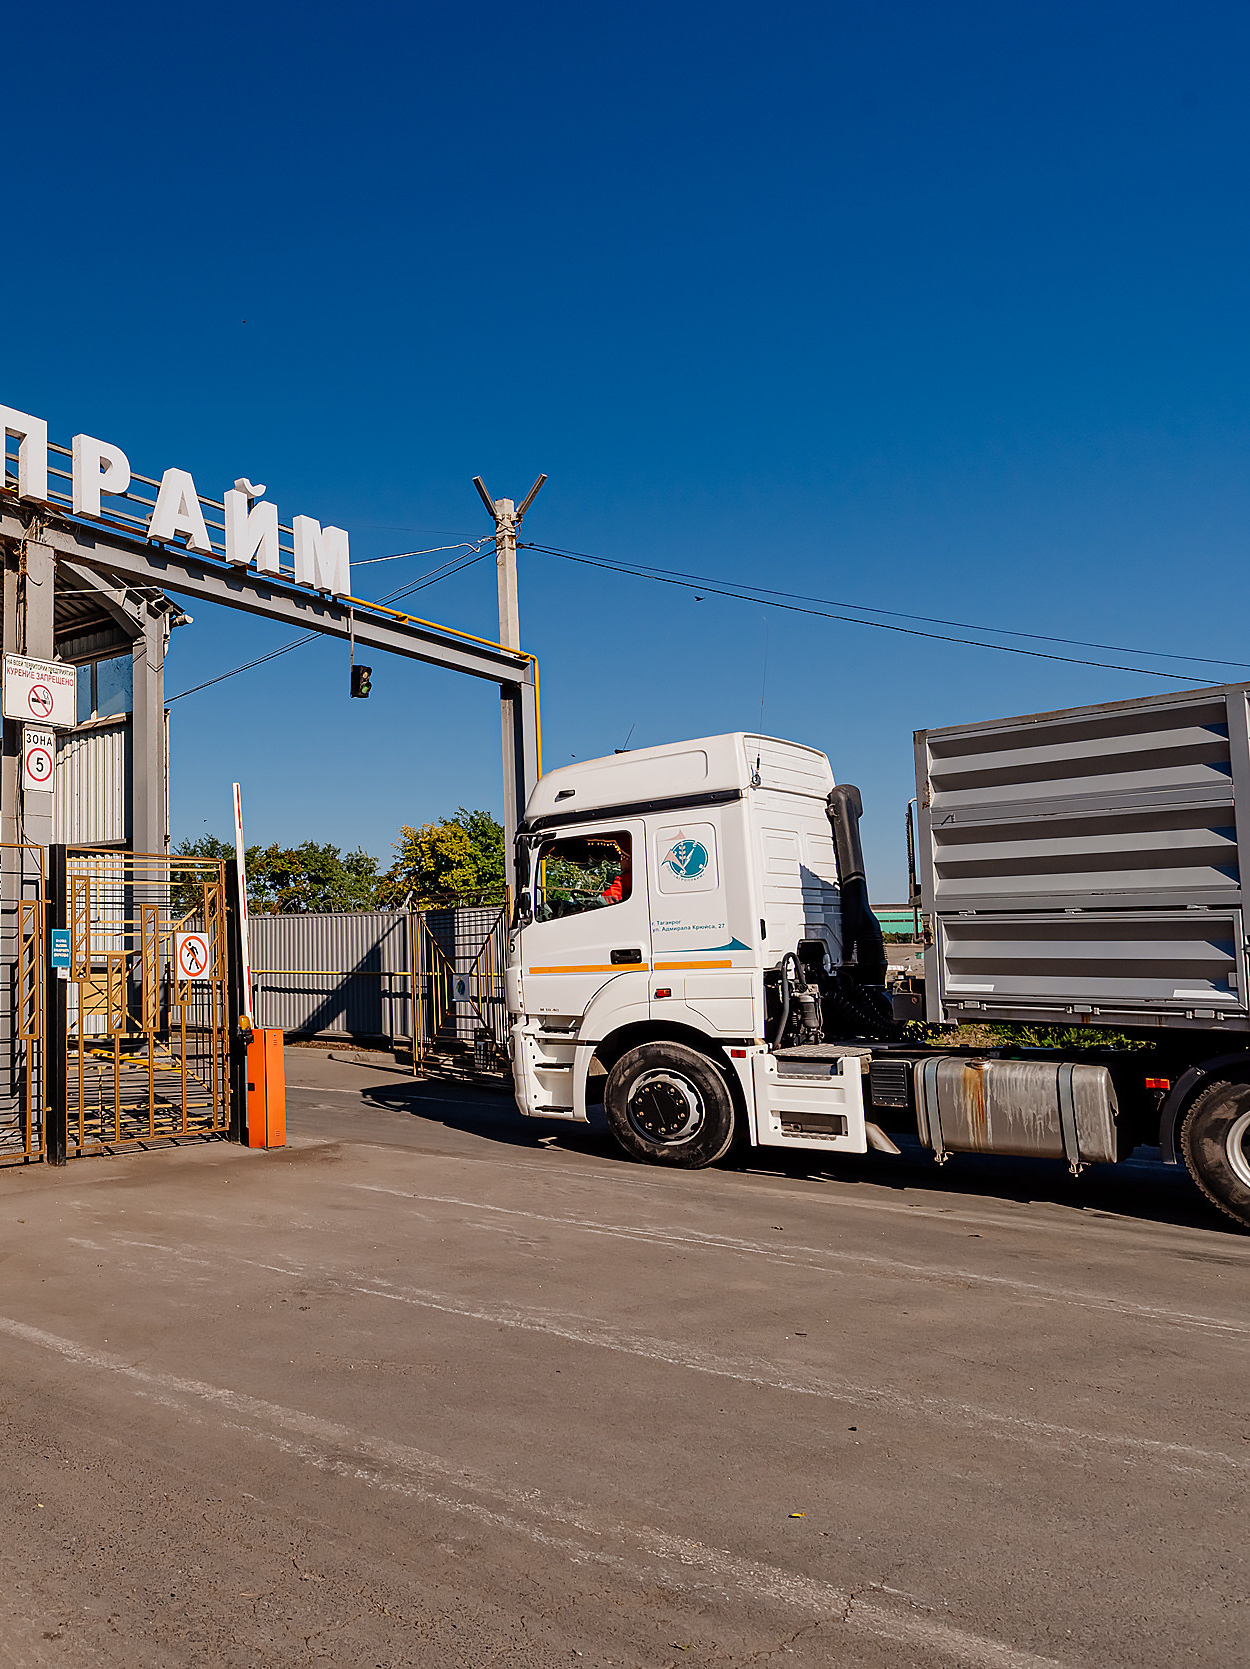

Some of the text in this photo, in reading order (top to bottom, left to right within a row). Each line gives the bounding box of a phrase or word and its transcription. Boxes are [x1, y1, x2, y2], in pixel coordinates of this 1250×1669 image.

[6, 667, 74, 687] КУРЕНИЕ ЗАПРЕЩЕНО
[26, 733, 53, 746] ЗОНА
[36, 757, 44, 772] 5
[661, 924, 691, 932] Адмирала
